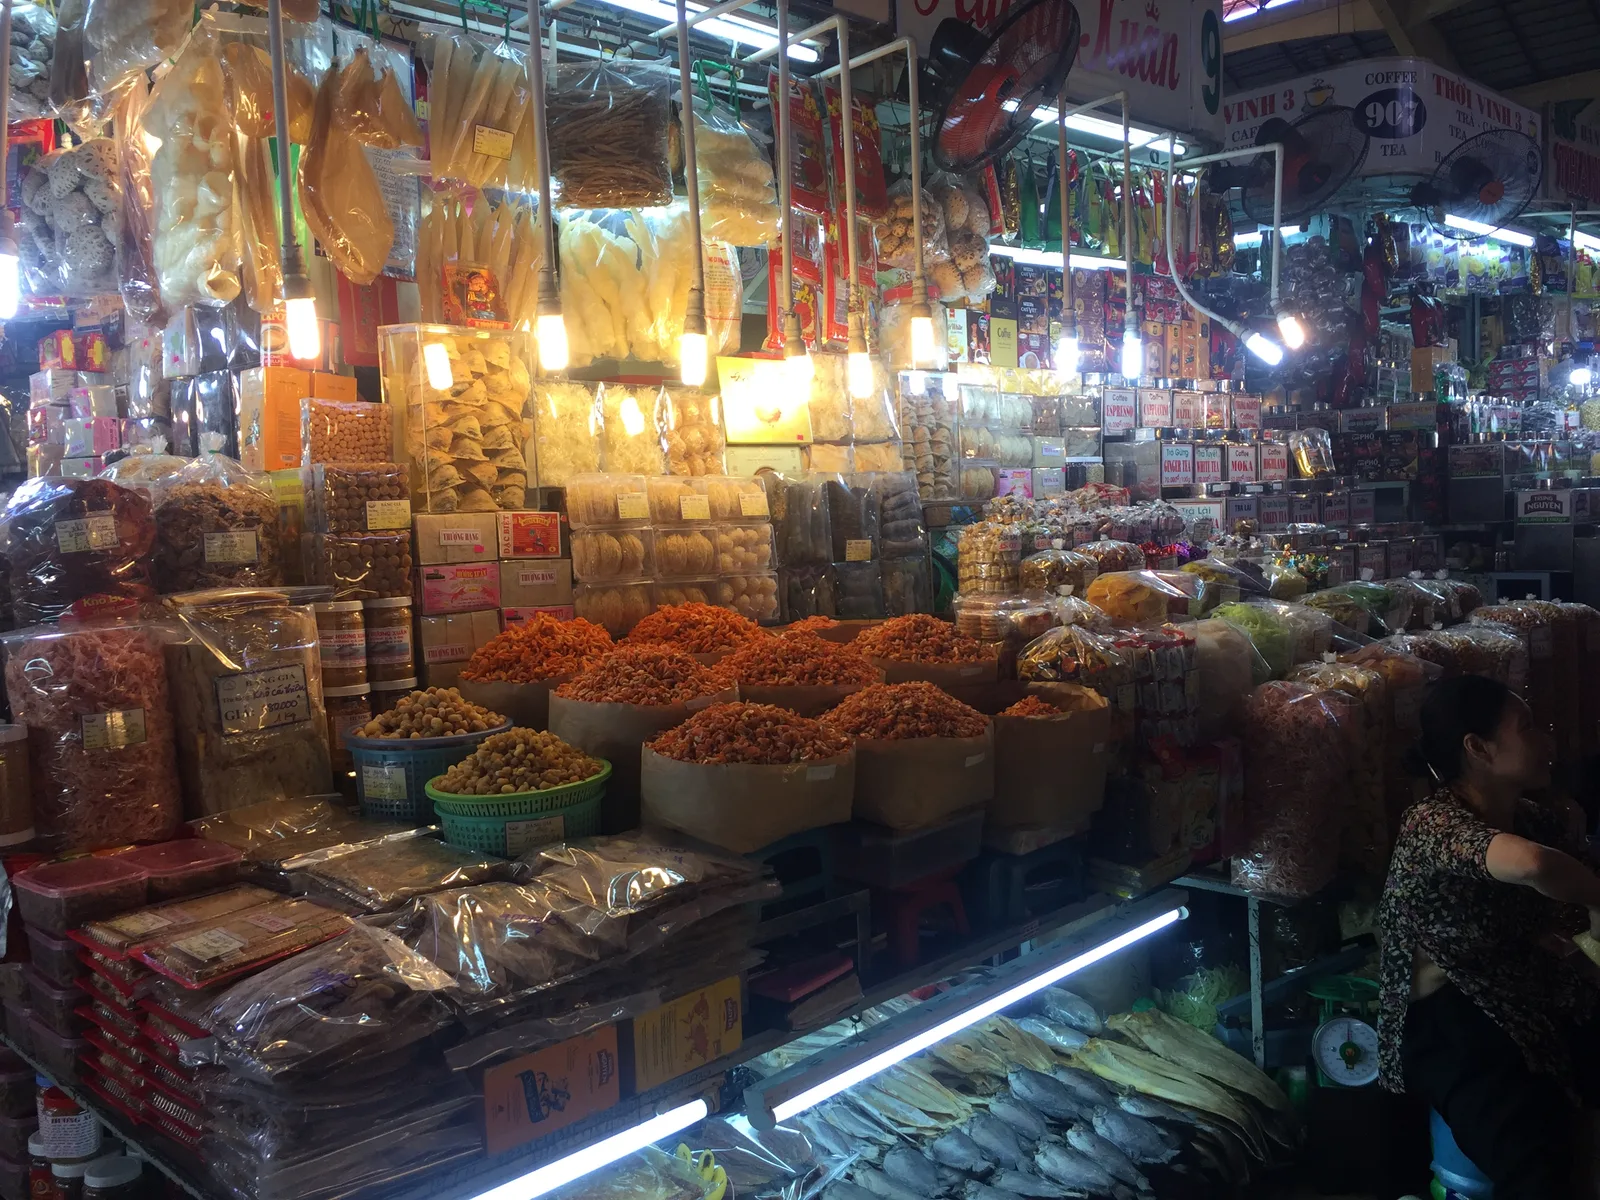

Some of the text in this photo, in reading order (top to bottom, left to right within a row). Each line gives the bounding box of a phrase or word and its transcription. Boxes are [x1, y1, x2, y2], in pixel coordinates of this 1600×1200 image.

[1201, 9, 1221, 115] 9
[1365, 71, 1417, 85] COFFEE
[1224, 89, 1295, 124] VINH 3
[1433, 73, 1523, 131] THỜI VINH 3
[1365, 101, 1419, 128] 907
[1232, 125, 1262, 142] CAF
[1449, 124, 1467, 142] TEA
[1381, 144, 1407, 157] TEA
[1106, 404, 1134, 418] ESPRESSO
[1164, 459, 1191, 473] GINGER TEA
[1197, 460, 1220, 473] WHITE TEA
[1231, 460, 1253, 472] MOKA
[1263, 458, 1286, 470] HIGHLAND
